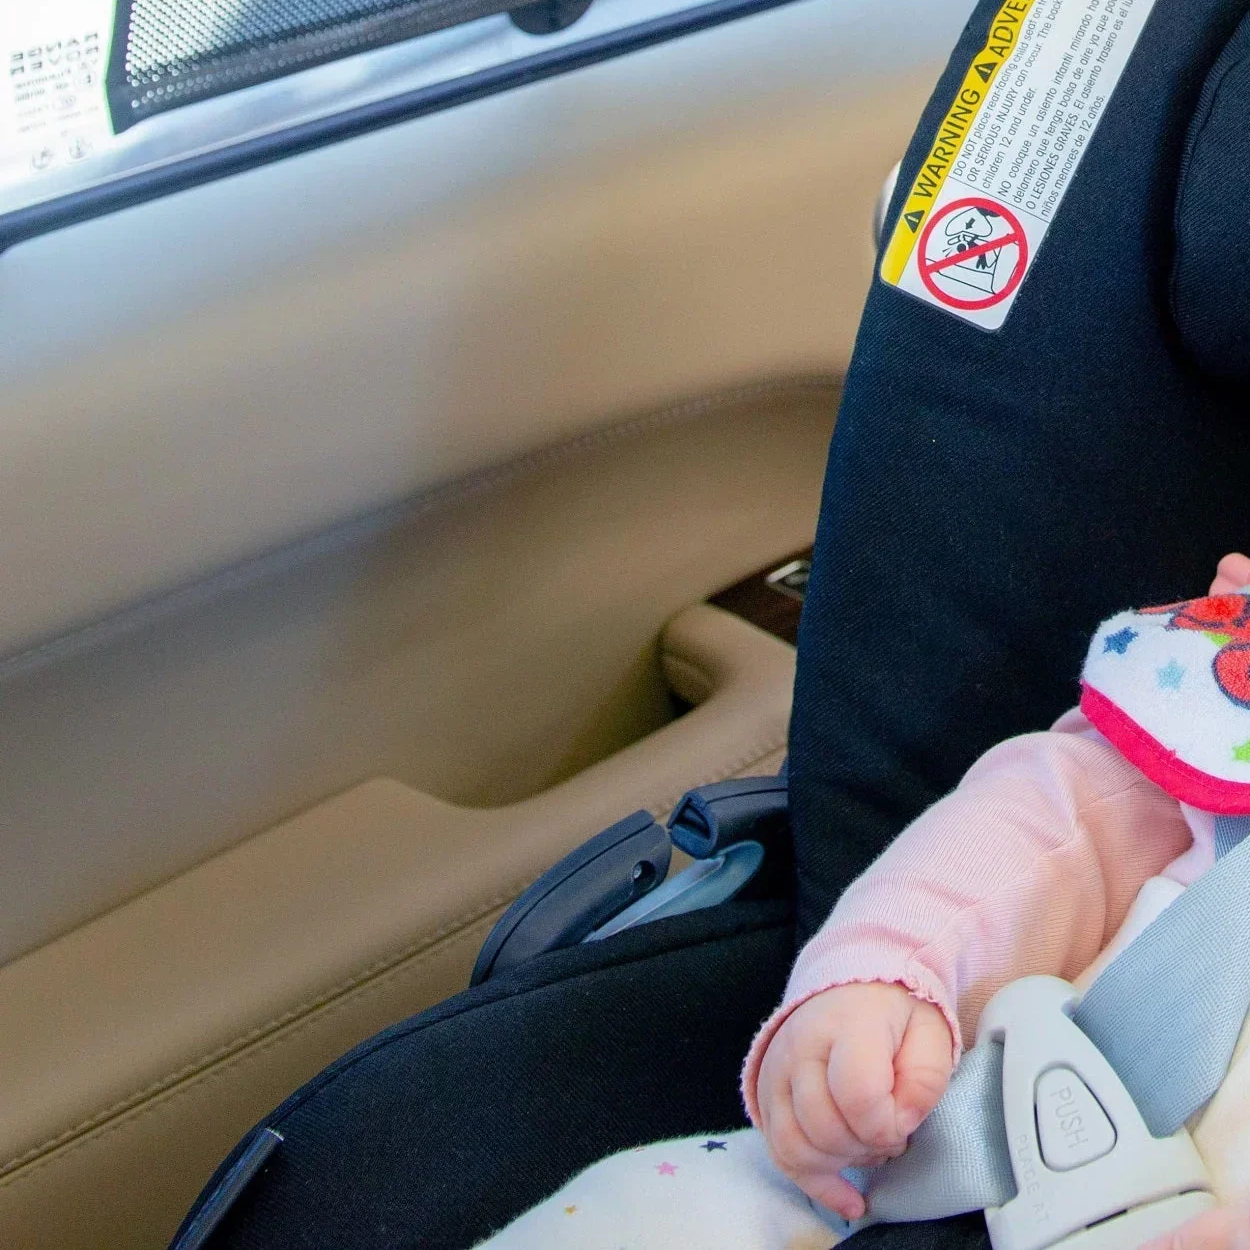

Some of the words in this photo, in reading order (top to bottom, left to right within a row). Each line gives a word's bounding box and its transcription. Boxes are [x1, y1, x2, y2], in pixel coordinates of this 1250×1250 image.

[1094, 13, 1110, 33] que
[1112, 18, 1124, 31] es
[1118, 7, 1129, 19] el
[1036, 21, 1052, 40] The
[1088, 33, 1101, 47] ya
[1024, 41, 1044, 68] occur.
[1078, 46, 1094, 66] aire
[1095, 31, 1118, 64] trasero
[1014, 68, 1029, 88] can
[1071, 66, 1084, 80] de
[1079, 64, 1102, 100] asiento
[952, 159, 967, 177] DO
[960, 137, 978, 160] NOT
[972, 111, 993, 140] place
[985, 61, 1019, 112] rear-facing
[1012, 41, 1030, 63] child
[1022, 19, 1038, 42] seat
[1032, 6, 1044, 19] on
[994, 87, 1019, 123] INJURY
[997, 179, 1012, 198] NO
[1007, 139, 1033, 179] coloque
[1027, 123, 1040, 138] un
[1034, 86, 1058, 122] asiento
[1052, 52, 1074, 86] infantil
[1069, 12, 1094, 52] mirando
[1056, 81, 1078, 108] bolsa
[1073, 98, 1086, 111] El
[1086, 93, 1106, 120] años.
[1043, 108, 1065, 137] tenga
[1052, 111, 1080, 152] GRAVES.
[1078, 119, 1093, 132] 12
[912, 87, 982, 200] WARNING
[973, 123, 1002, 167] SERIOUS
[981, 150, 1006, 189] children
[998, 135, 1013, 148] 12
[1006, 115, 1023, 136] and
[1016, 86, 1038, 116] under.
[1035, 137, 1051, 158] que
[1072, 133, 1086, 148] de
[966, 166, 981, 183] OR
[1010, 158, 1041, 204] delantero
[1030, 151, 1060, 200] LESIONES
[1053, 147, 1080, 190] menores
[1025, 199, 1037, 210] O
[1039, 189, 1059, 218] niños
[1050, 1085, 1089, 1150] PUSH
